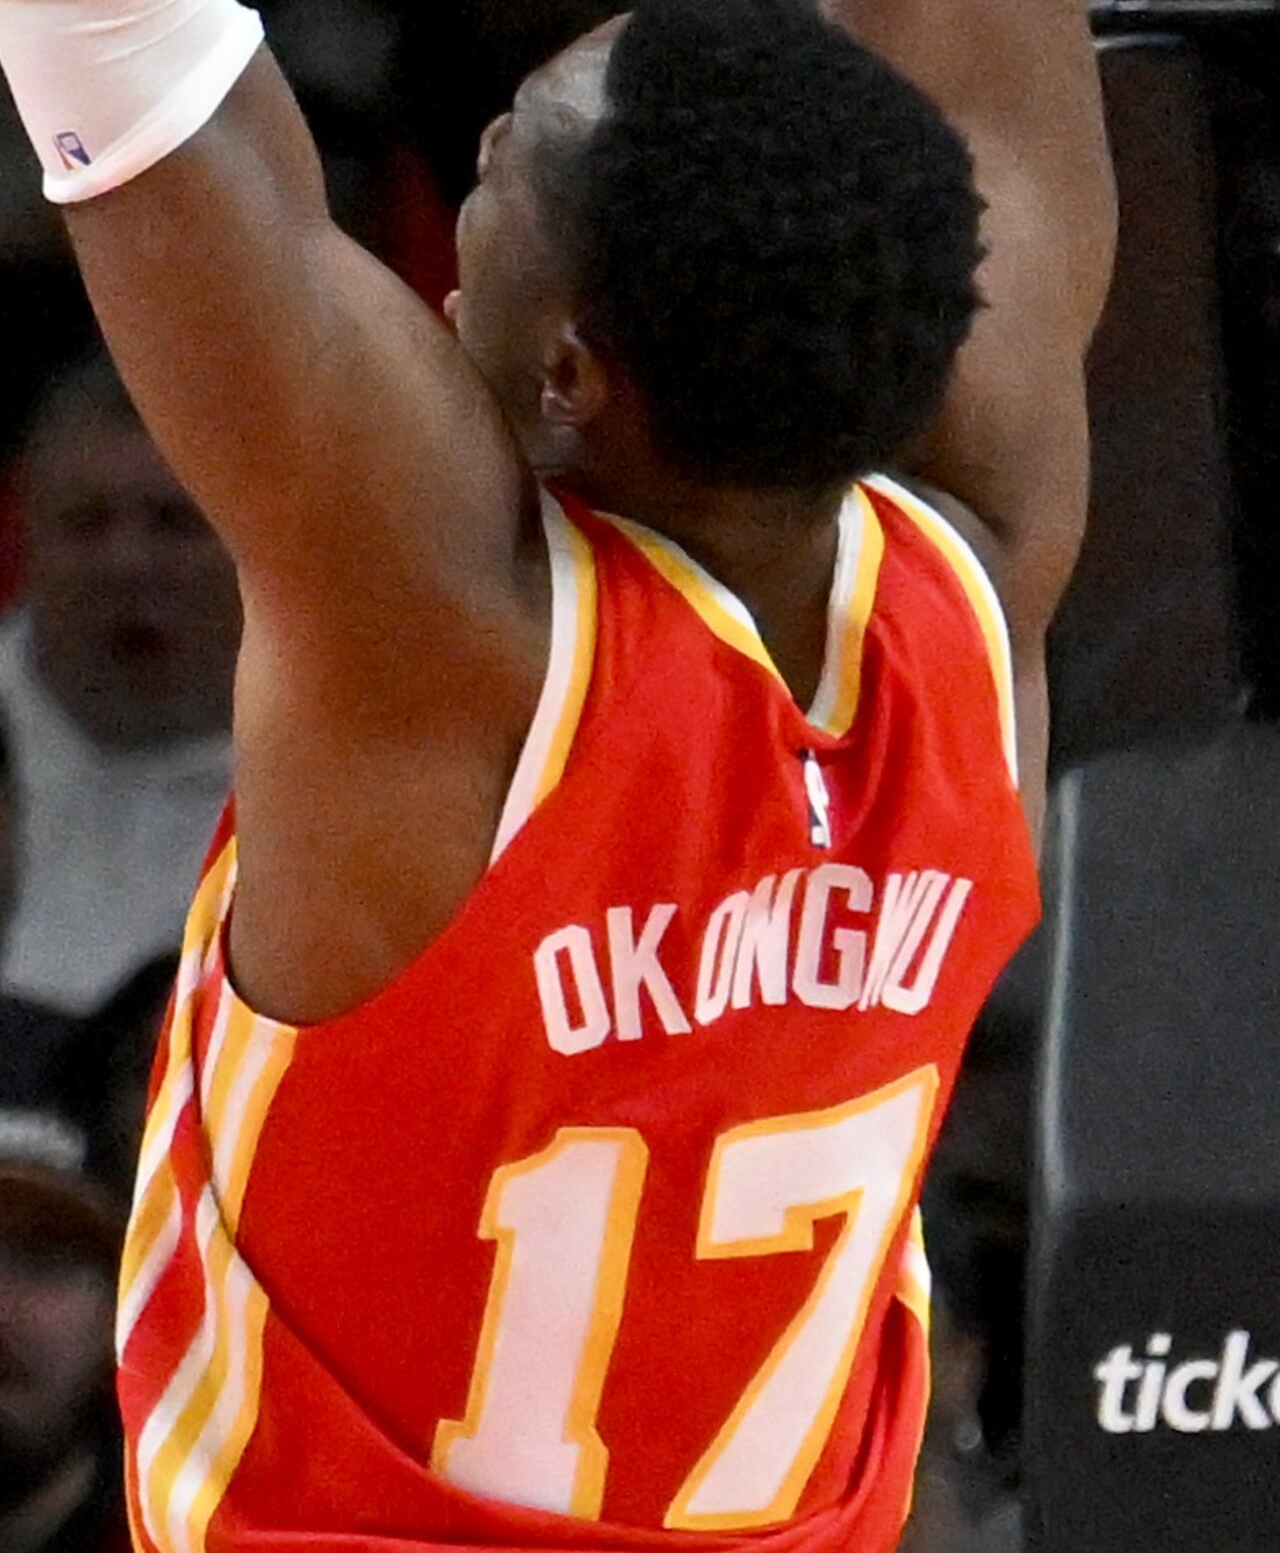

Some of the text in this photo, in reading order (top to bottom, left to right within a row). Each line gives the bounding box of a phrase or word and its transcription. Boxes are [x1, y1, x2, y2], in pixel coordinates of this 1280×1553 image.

[533, 863, 973, 1057] OKONGWU
[430, 1063, 939, 1531] 17
[1094, 1330, 1280, 1434] tick
